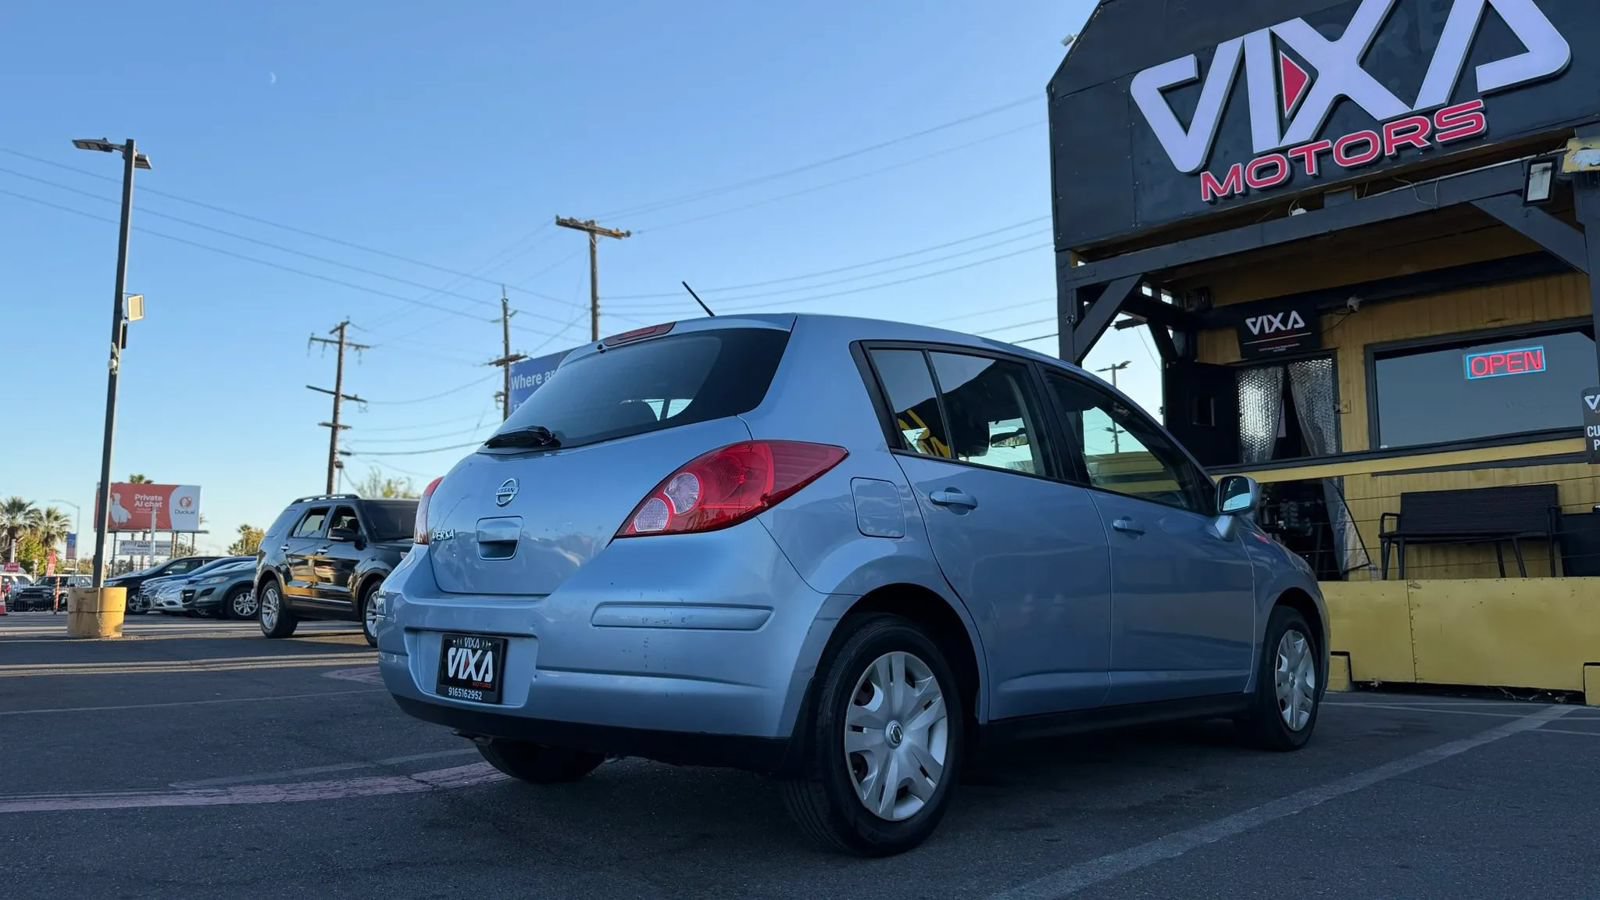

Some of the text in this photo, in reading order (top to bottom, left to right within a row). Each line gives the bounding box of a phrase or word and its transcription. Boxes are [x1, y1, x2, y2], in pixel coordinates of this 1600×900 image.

[1130, 0, 1571, 173] VIXA
[1200, 99, 1485, 202] MOTORS
[1245, 310, 1305, 335] VIXA
[1471, 350, 1542, 376] OPEN
[511, 373, 542, 390] Where
[464, 637, 480, 648] VIXA
[448, 647, 493, 682] VIXA
